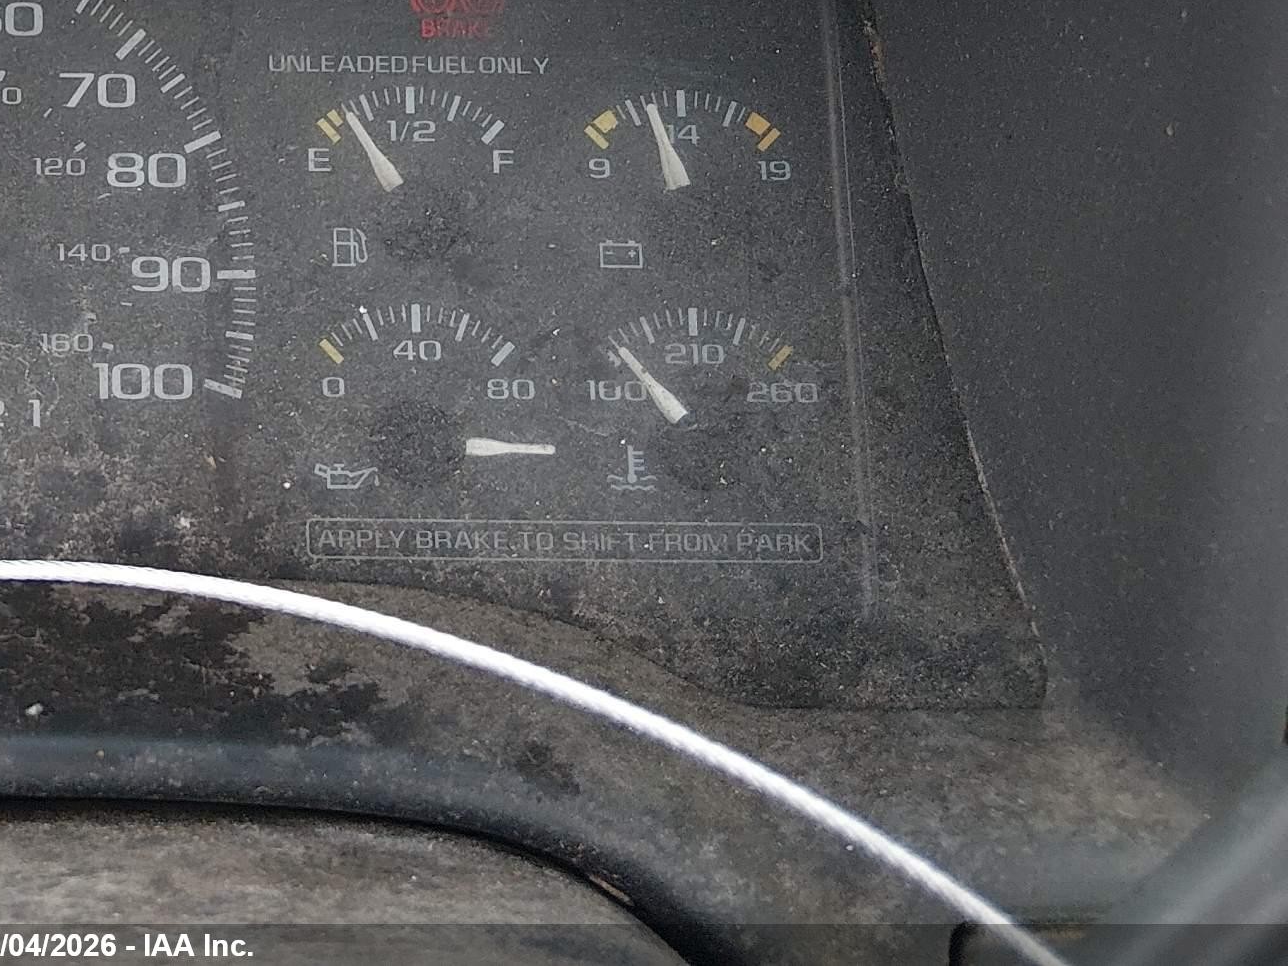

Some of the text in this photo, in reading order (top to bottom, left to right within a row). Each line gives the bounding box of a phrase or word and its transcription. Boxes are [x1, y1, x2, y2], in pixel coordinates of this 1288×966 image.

[268, 54, 550, 75] UNLEADED FUEL ONLY
[59, 73, 136, 108] 70
[387, 120, 436, 142] 1/2
[665, 124, 700, 145] 14
[33, 157, 87, 177] 120
[106, 152, 187, 188] 80
[308, 147, 332, 172] E
[492, 149, 514, 174] F
[588, 158, 611, 179] 9
[757, 160, 792, 181] 19
[57, 243, 112, 262] 140
[131, 256, 211, 292] 90
[39, 333, 94, 352] 160
[393, 339, 442, 361] 40
[664, 343, 725, 365] 210
[92, 362, 193, 400] 100
[322, 376, 345, 398] 0
[487, 378, 536, 400] 80
[746, 382, 819, 403] 260
[28, 399, 42, 427] 1
[317, 529, 812, 553] APPLY BRAKE TO SHIFT FROM PARK
